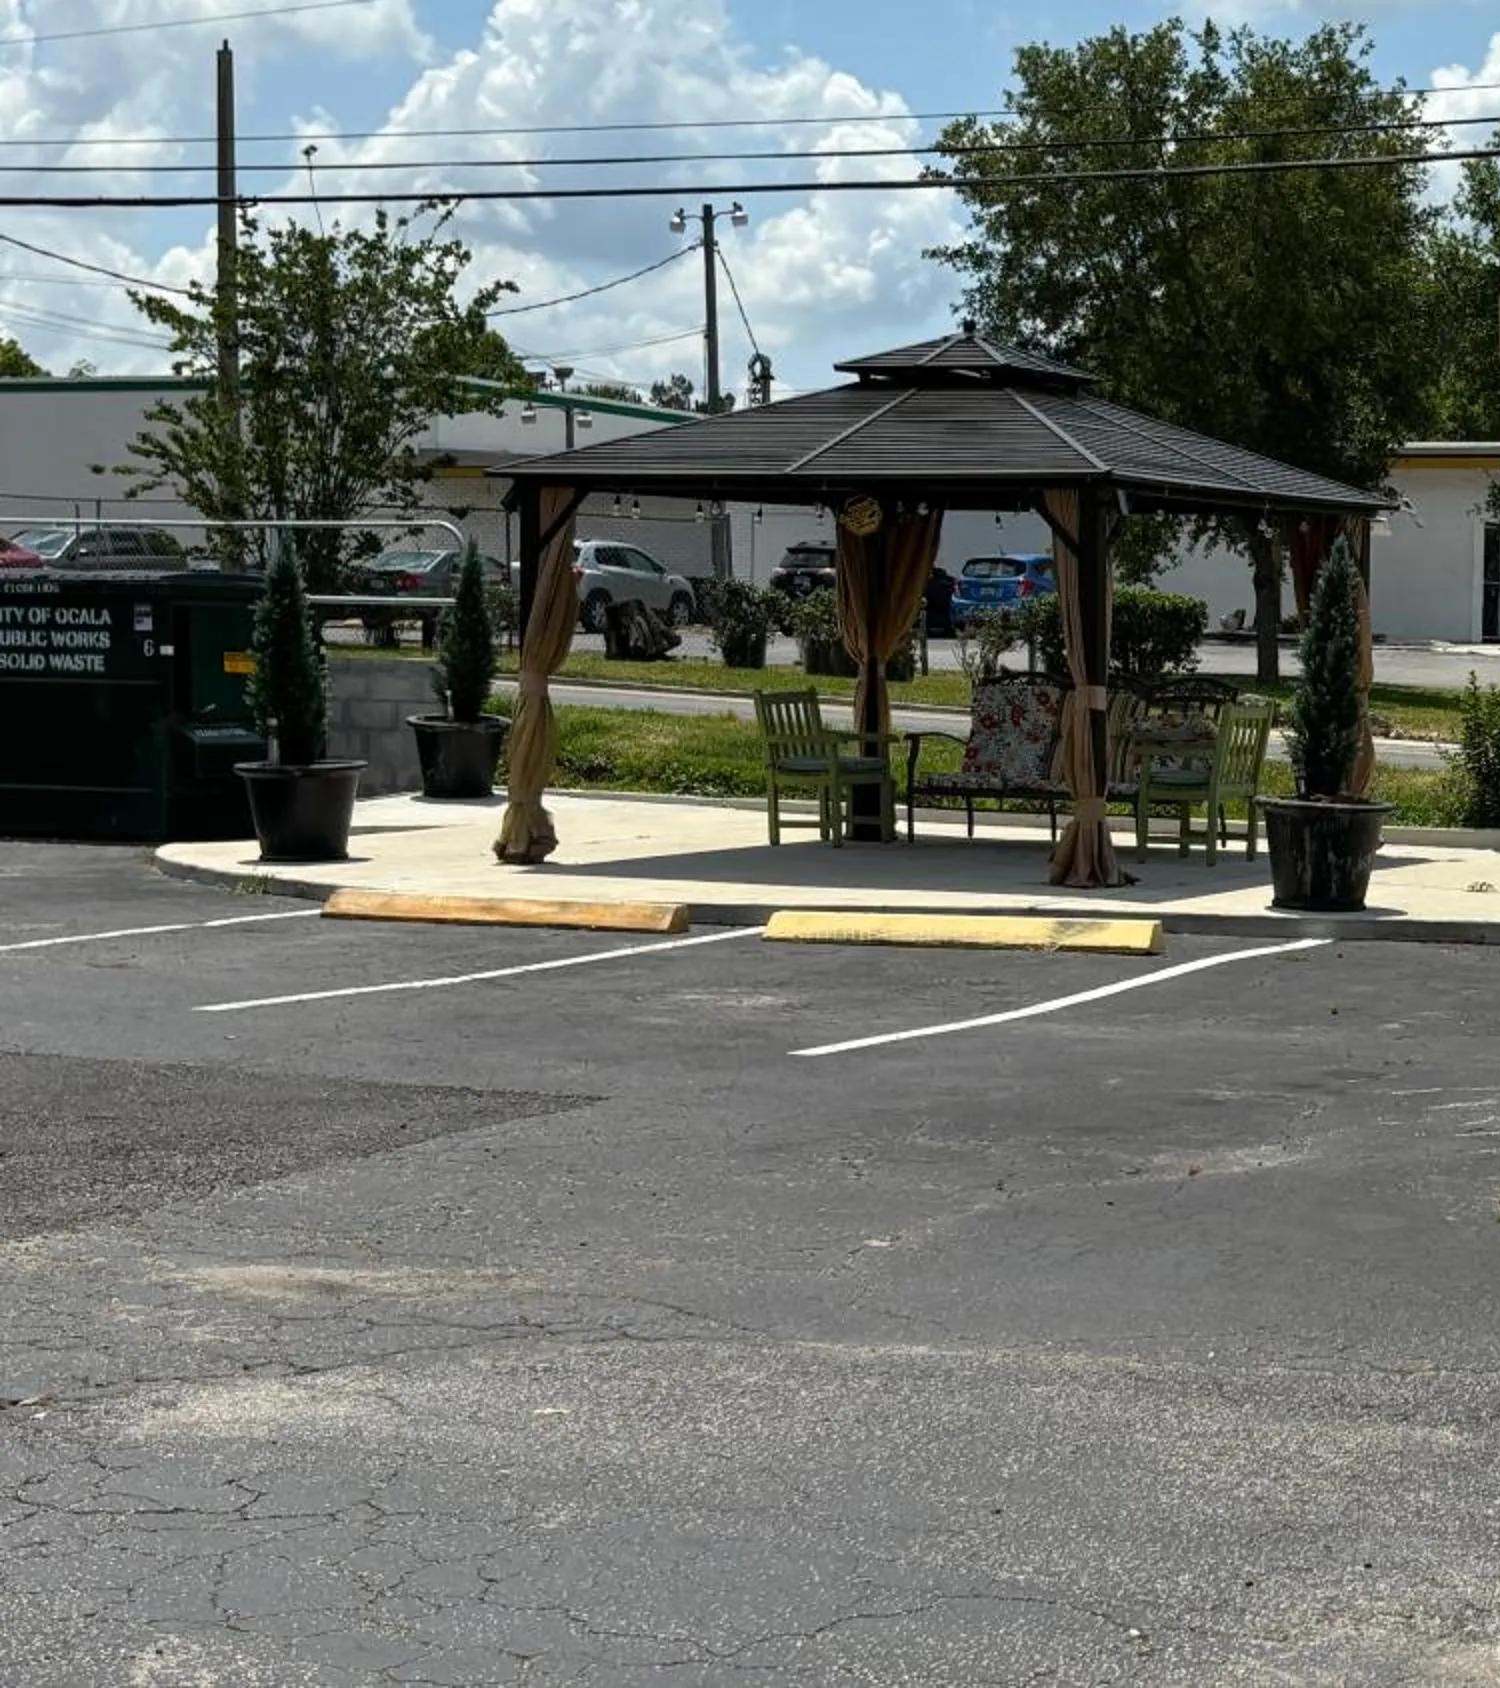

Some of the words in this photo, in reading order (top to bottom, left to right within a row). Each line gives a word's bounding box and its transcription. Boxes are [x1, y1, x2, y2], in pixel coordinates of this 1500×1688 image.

[0, 607, 24, 624] ITY
[28, 607, 51, 624] OF
[55, 608, 112, 625] OCALA
[0, 630, 47, 647] UBLIC
[51, 631, 111, 648] WORKS
[144, 639, 154, 657] 6
[0, 653, 46, 670] SOLID
[49, 654, 105, 671] WASTE
